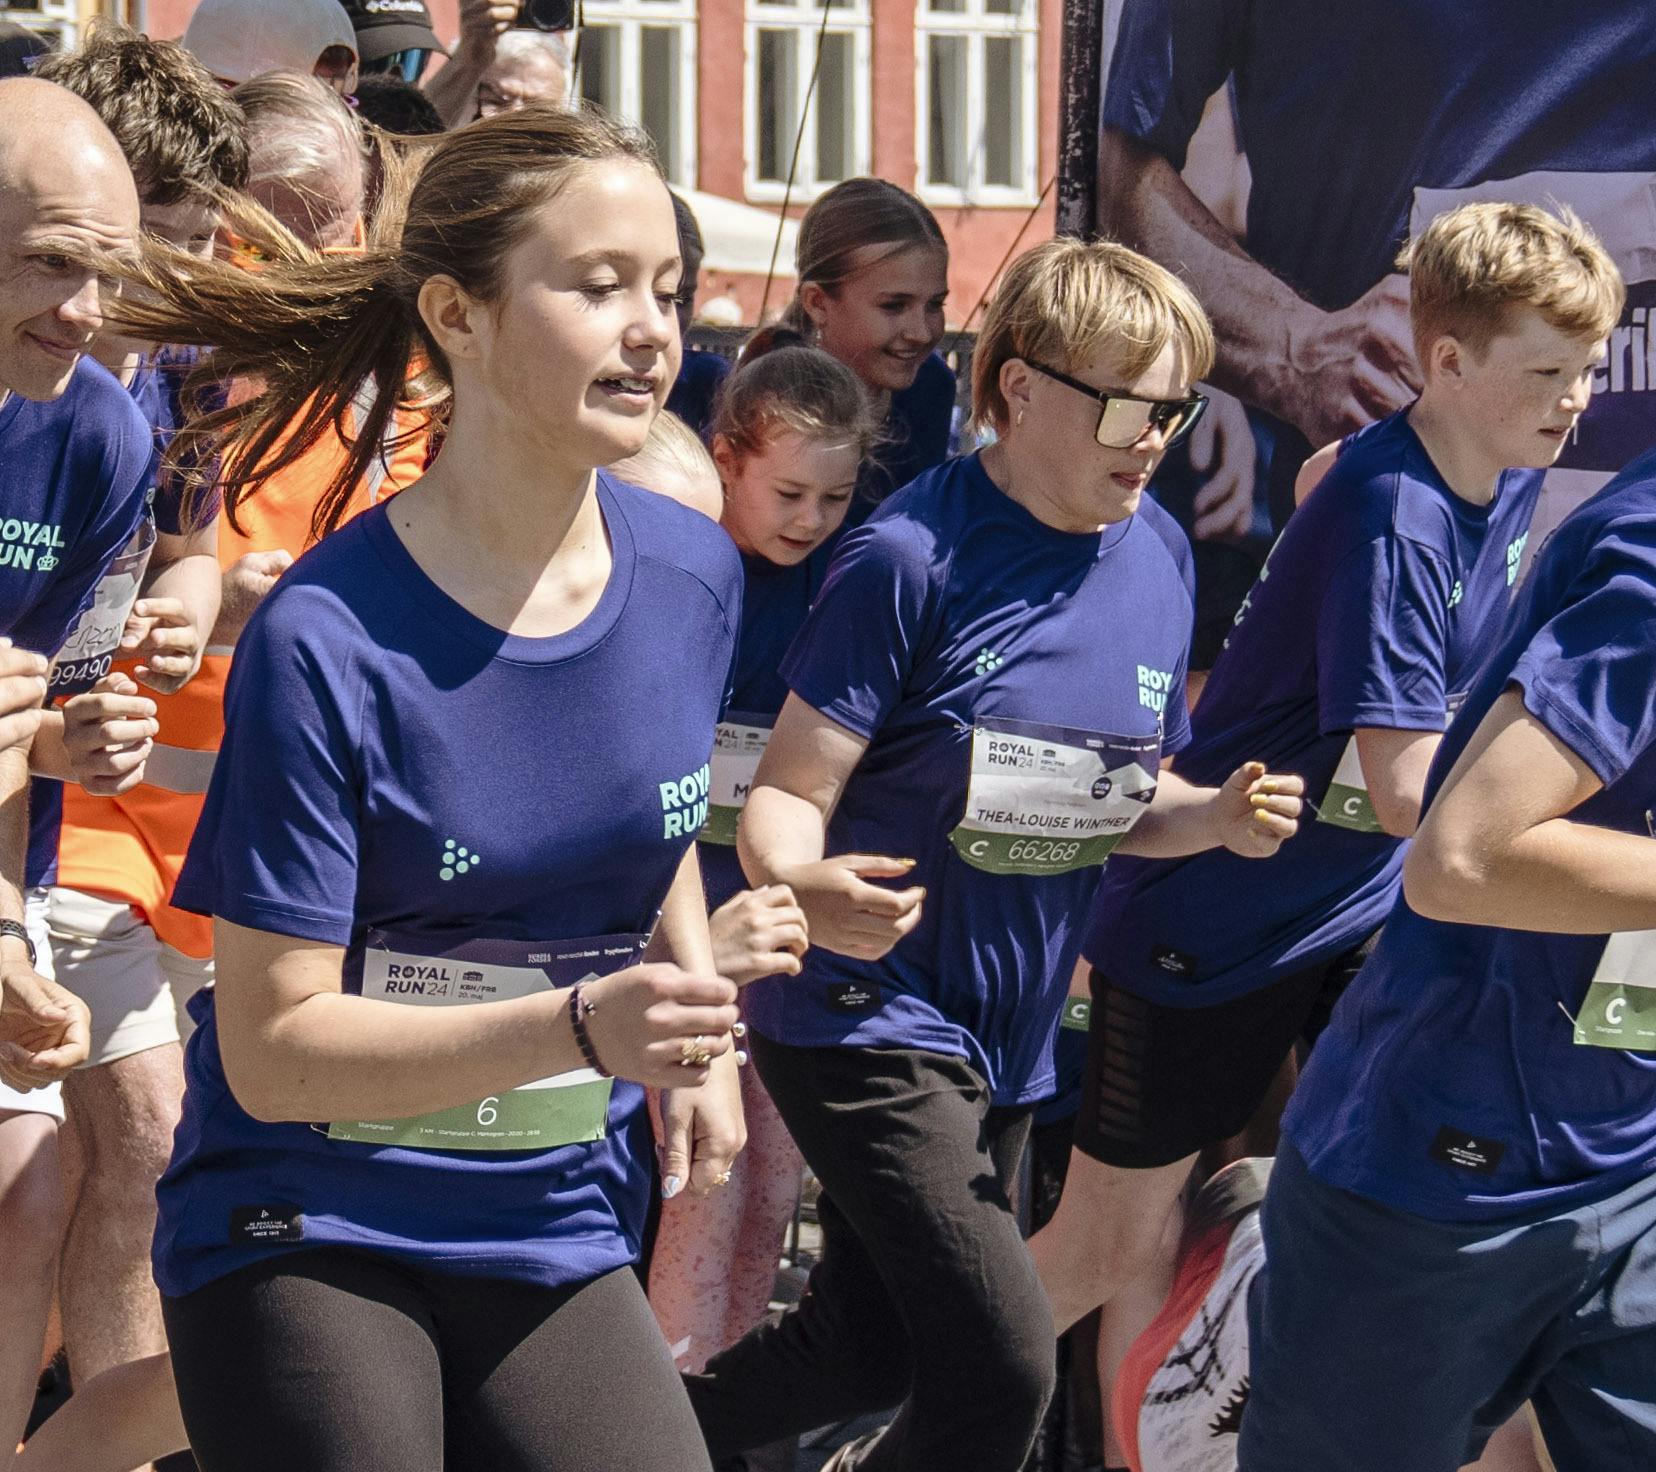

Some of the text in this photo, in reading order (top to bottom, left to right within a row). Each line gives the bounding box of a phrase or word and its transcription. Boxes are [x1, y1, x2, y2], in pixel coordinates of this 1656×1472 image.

[1138, 665, 1172, 692] ROY
[989, 742, 1034, 756] ROYAL
[660, 763, 710, 810] ROY
[1343, 796, 1363, 818] C
[977, 809, 1131, 829] THEA-LOUISE WINTHER
[969, 840, 1080, 861] C 66268
[388, 964, 451, 981] ROYAL
[1605, 997, 1626, 1025] C
[477, 1097, 499, 1126] 6
